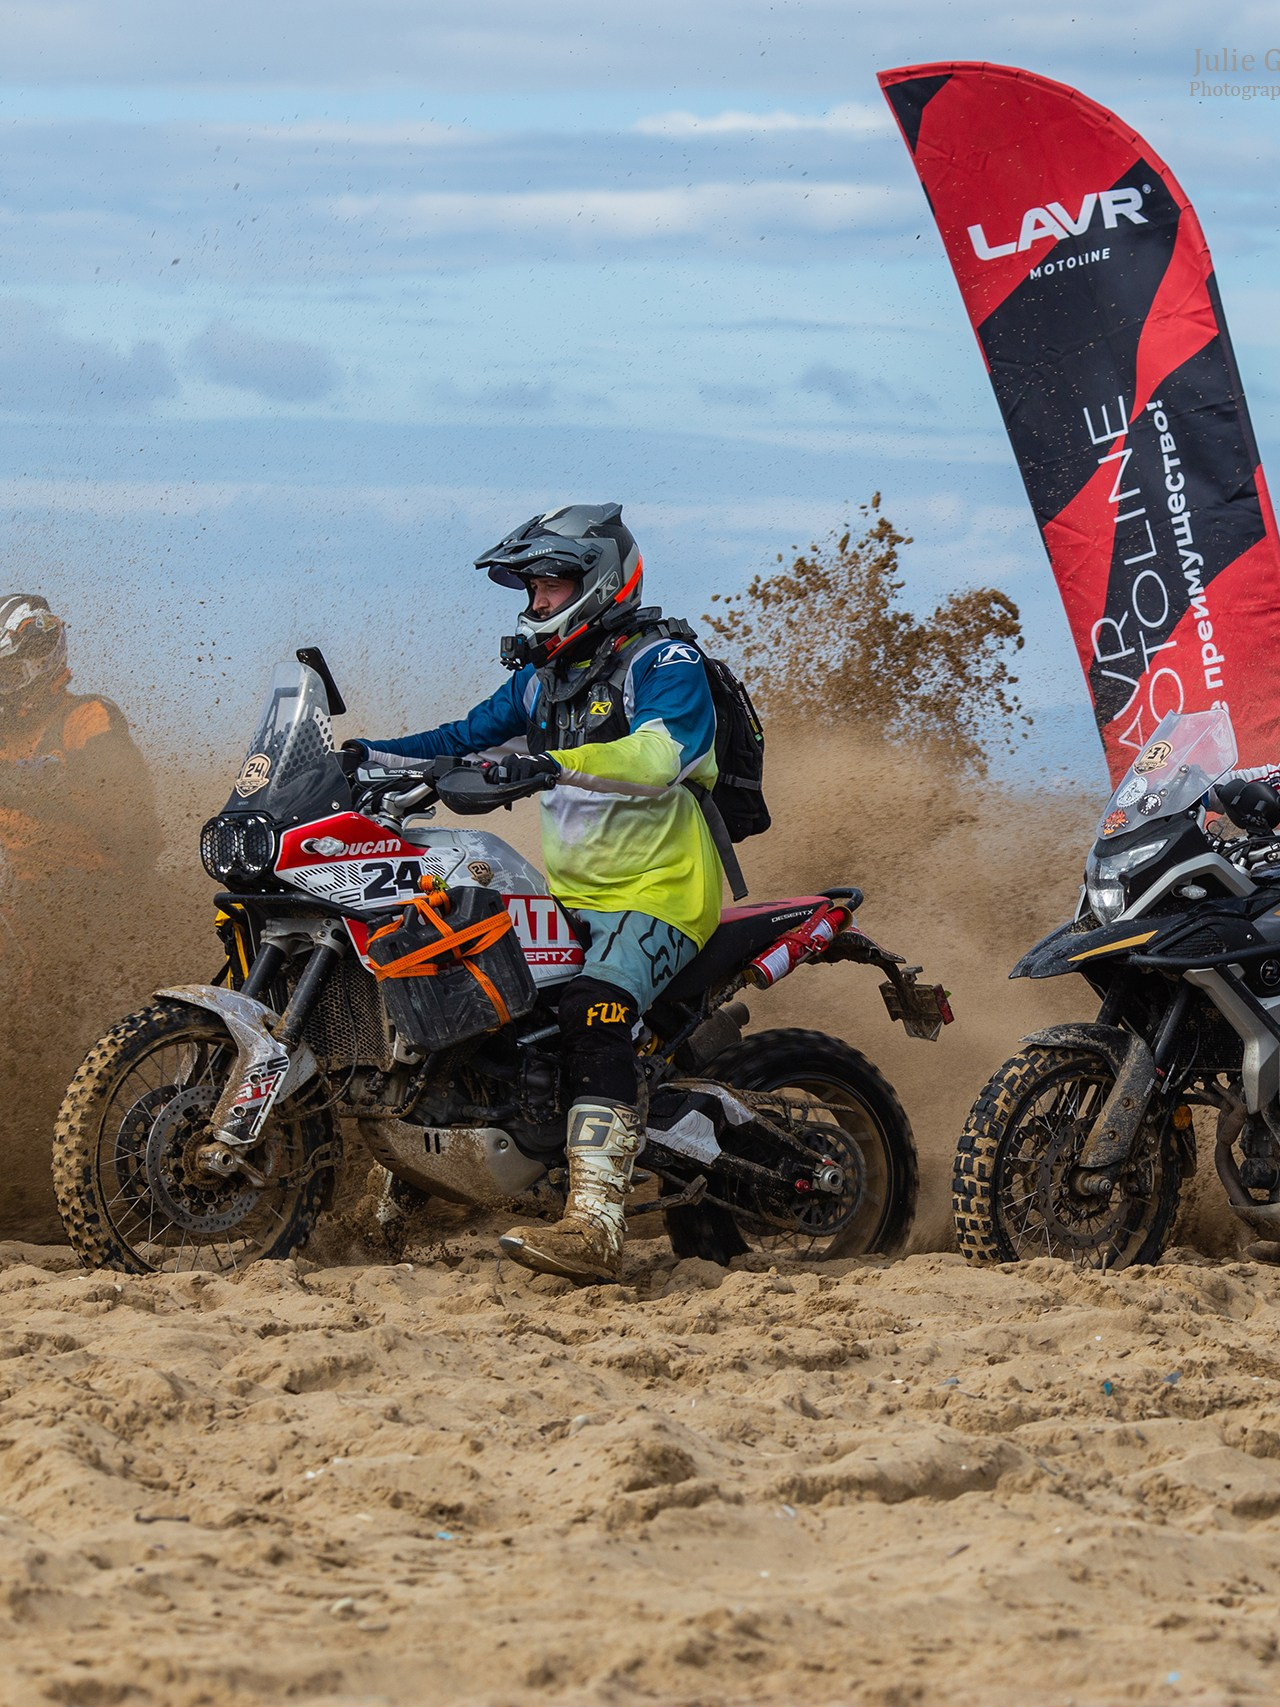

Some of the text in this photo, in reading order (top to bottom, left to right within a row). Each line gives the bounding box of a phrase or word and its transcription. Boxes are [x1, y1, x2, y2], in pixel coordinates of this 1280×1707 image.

[967, 186, 1149, 261] LAVR
[1029, 247, 1111, 280] MOTOLINE
[1082, 395, 1184, 724] OTOLINE
[1145, 398, 1225, 690] преимущество!
[1090, 610, 1145, 752] AVR
[245, 762, 264, 778] 24
[361, 860, 423, 901] 24
[471, 864, 488, 875] 24
[506, 898, 571, 948] ATI
[771, 909, 814, 923] DESERTX
[524, 949, 574, 963] ERTX
[586, 1002, 631, 1027] FOX
